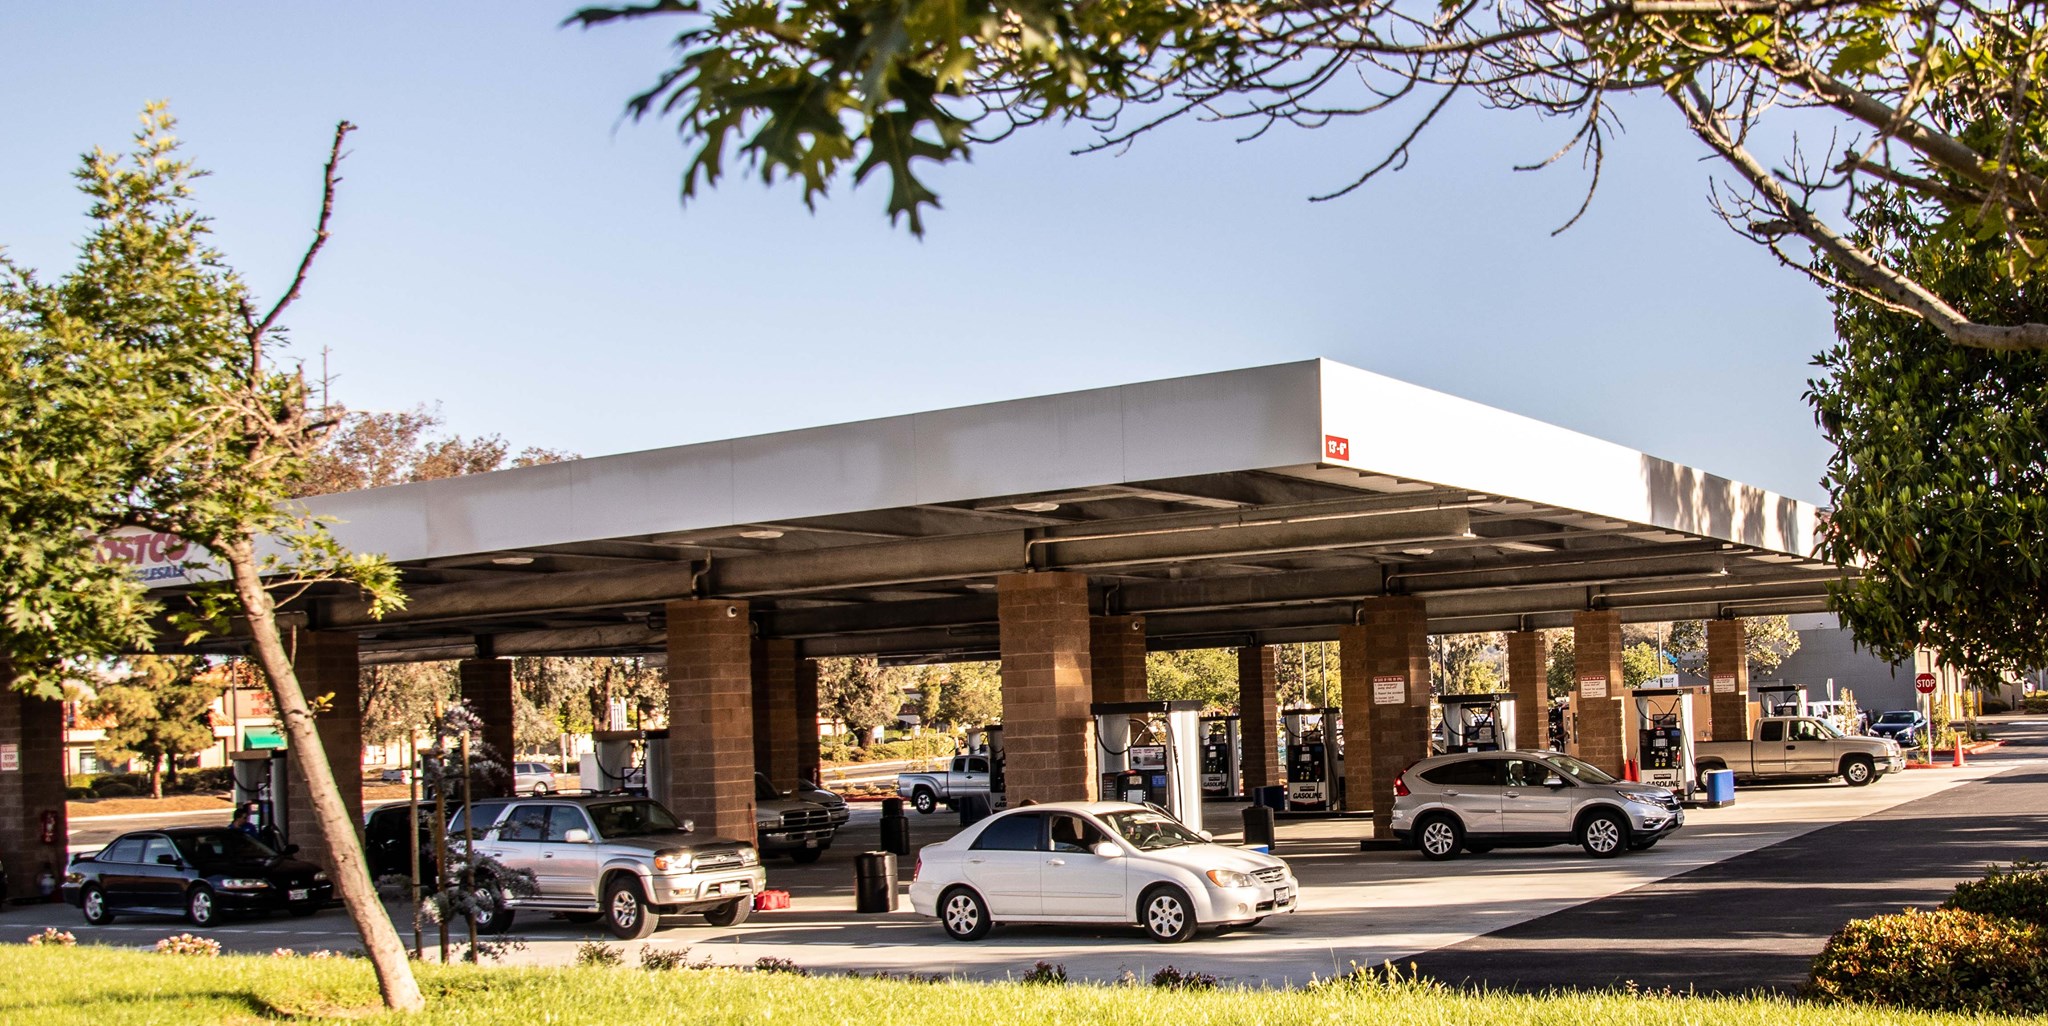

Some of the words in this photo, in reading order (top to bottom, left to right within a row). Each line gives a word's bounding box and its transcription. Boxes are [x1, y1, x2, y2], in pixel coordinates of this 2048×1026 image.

[86, 532, 188, 565] OSTCO
[1916, 679, 1935, 688] STOP
[1162, 702, 1168, 711] 7
